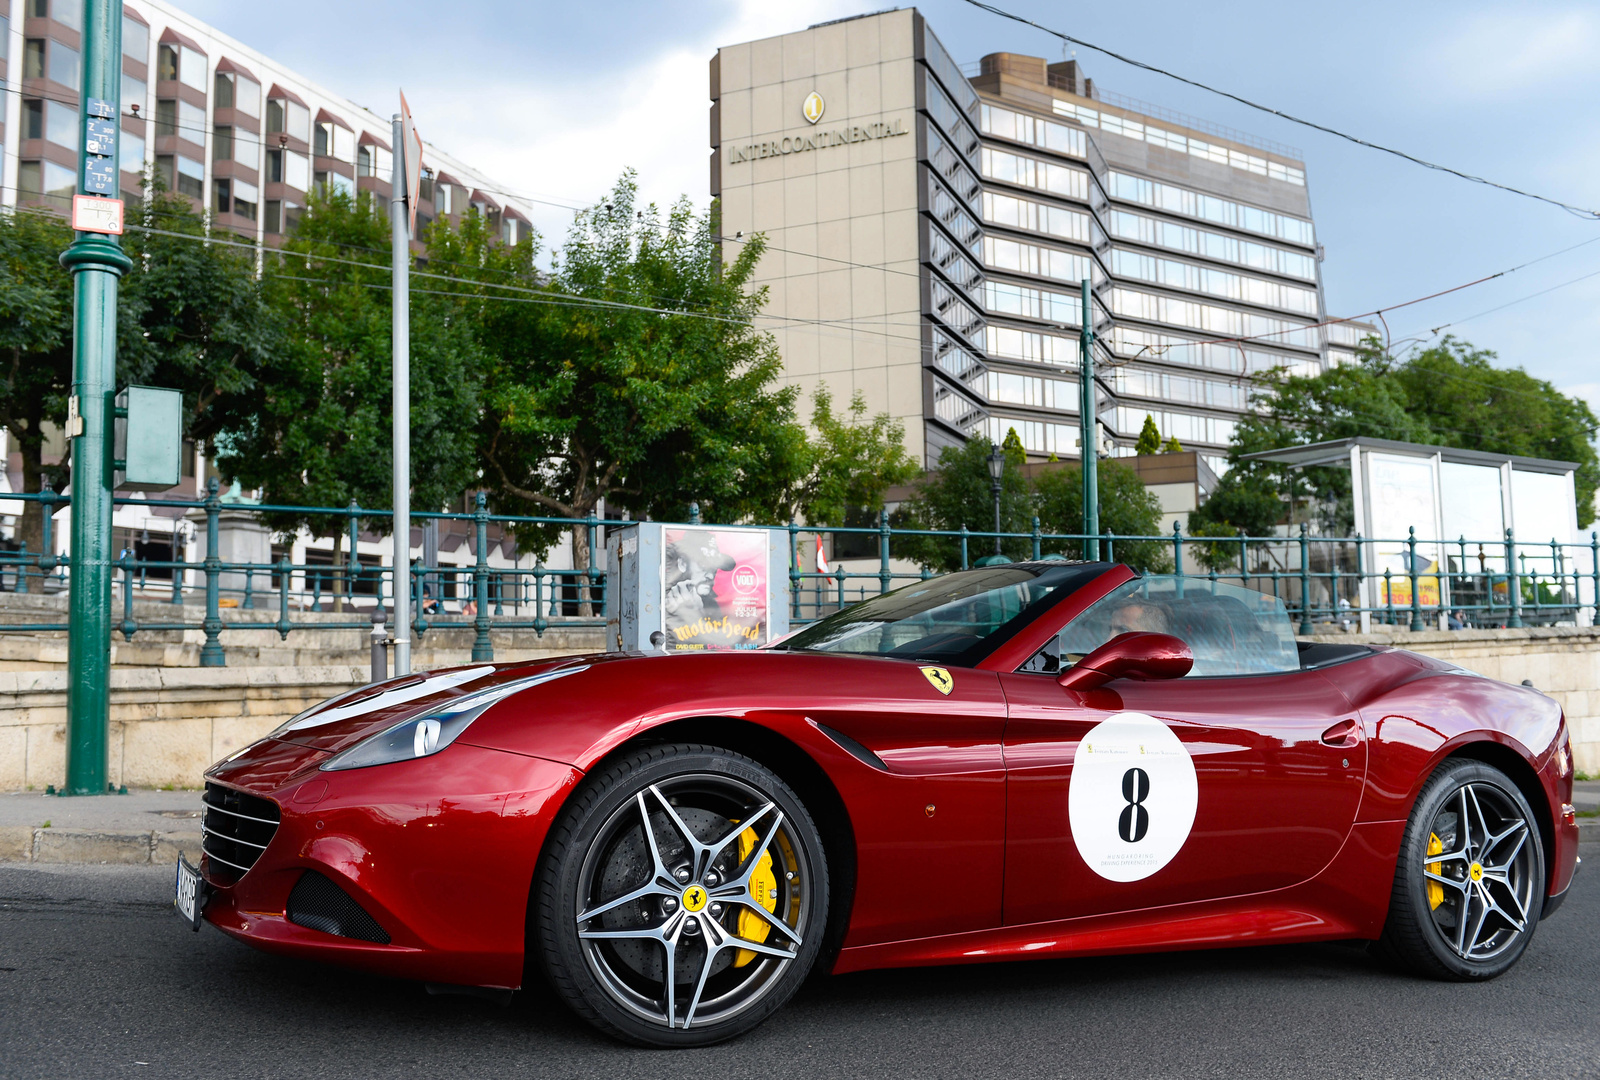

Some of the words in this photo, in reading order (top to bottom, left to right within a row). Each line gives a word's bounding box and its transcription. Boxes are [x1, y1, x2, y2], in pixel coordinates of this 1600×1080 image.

[88, 121, 95, 131] Z
[729, 118, 909, 164] INTERCONTINENTAL
[86, 160, 93, 170] Z
[736, 574, 754, 586] VOLT
[1118, 767, 1150, 843] 8
